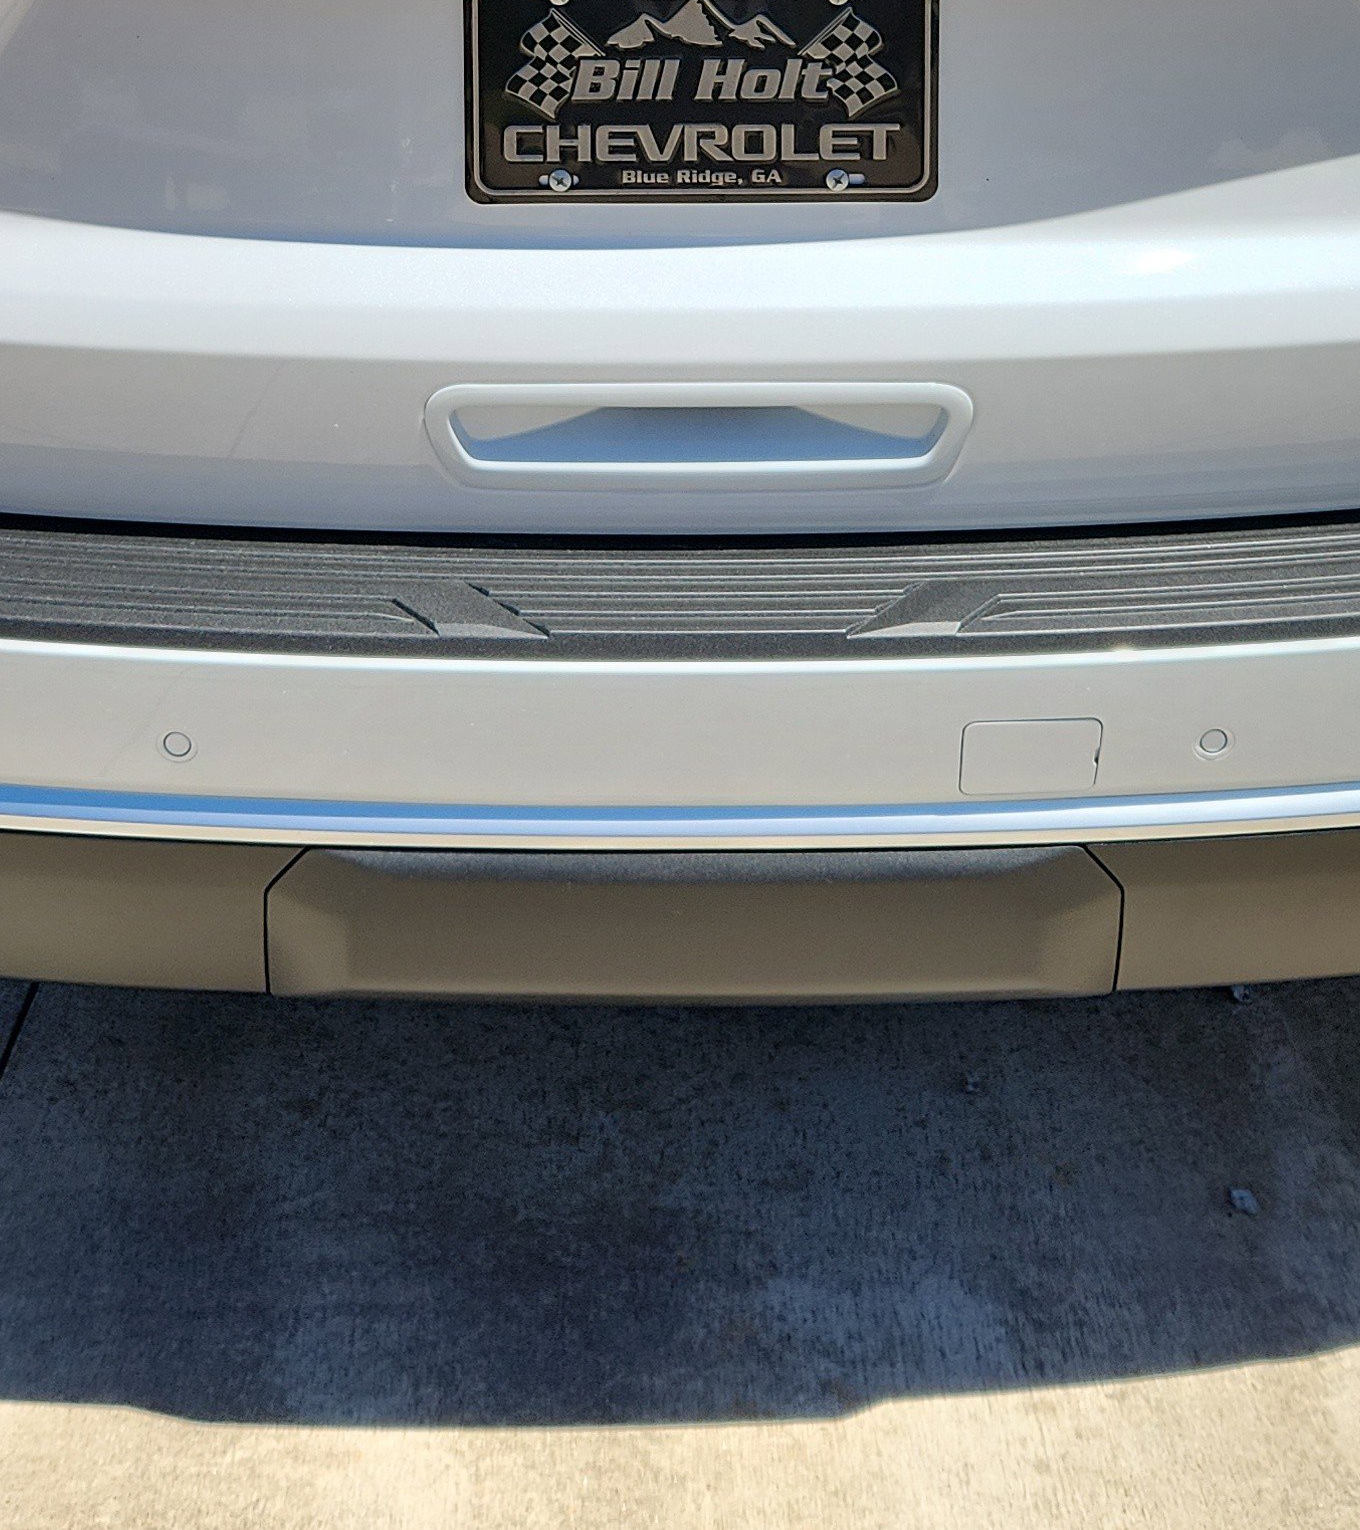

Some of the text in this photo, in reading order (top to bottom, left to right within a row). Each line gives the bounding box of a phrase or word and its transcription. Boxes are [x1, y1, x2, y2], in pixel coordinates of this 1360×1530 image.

[571, 58, 832, 101] Bill Holt
[503, 123, 900, 162] CHEVROLET
[622, 169, 782, 187] Blue Ridge, GA
